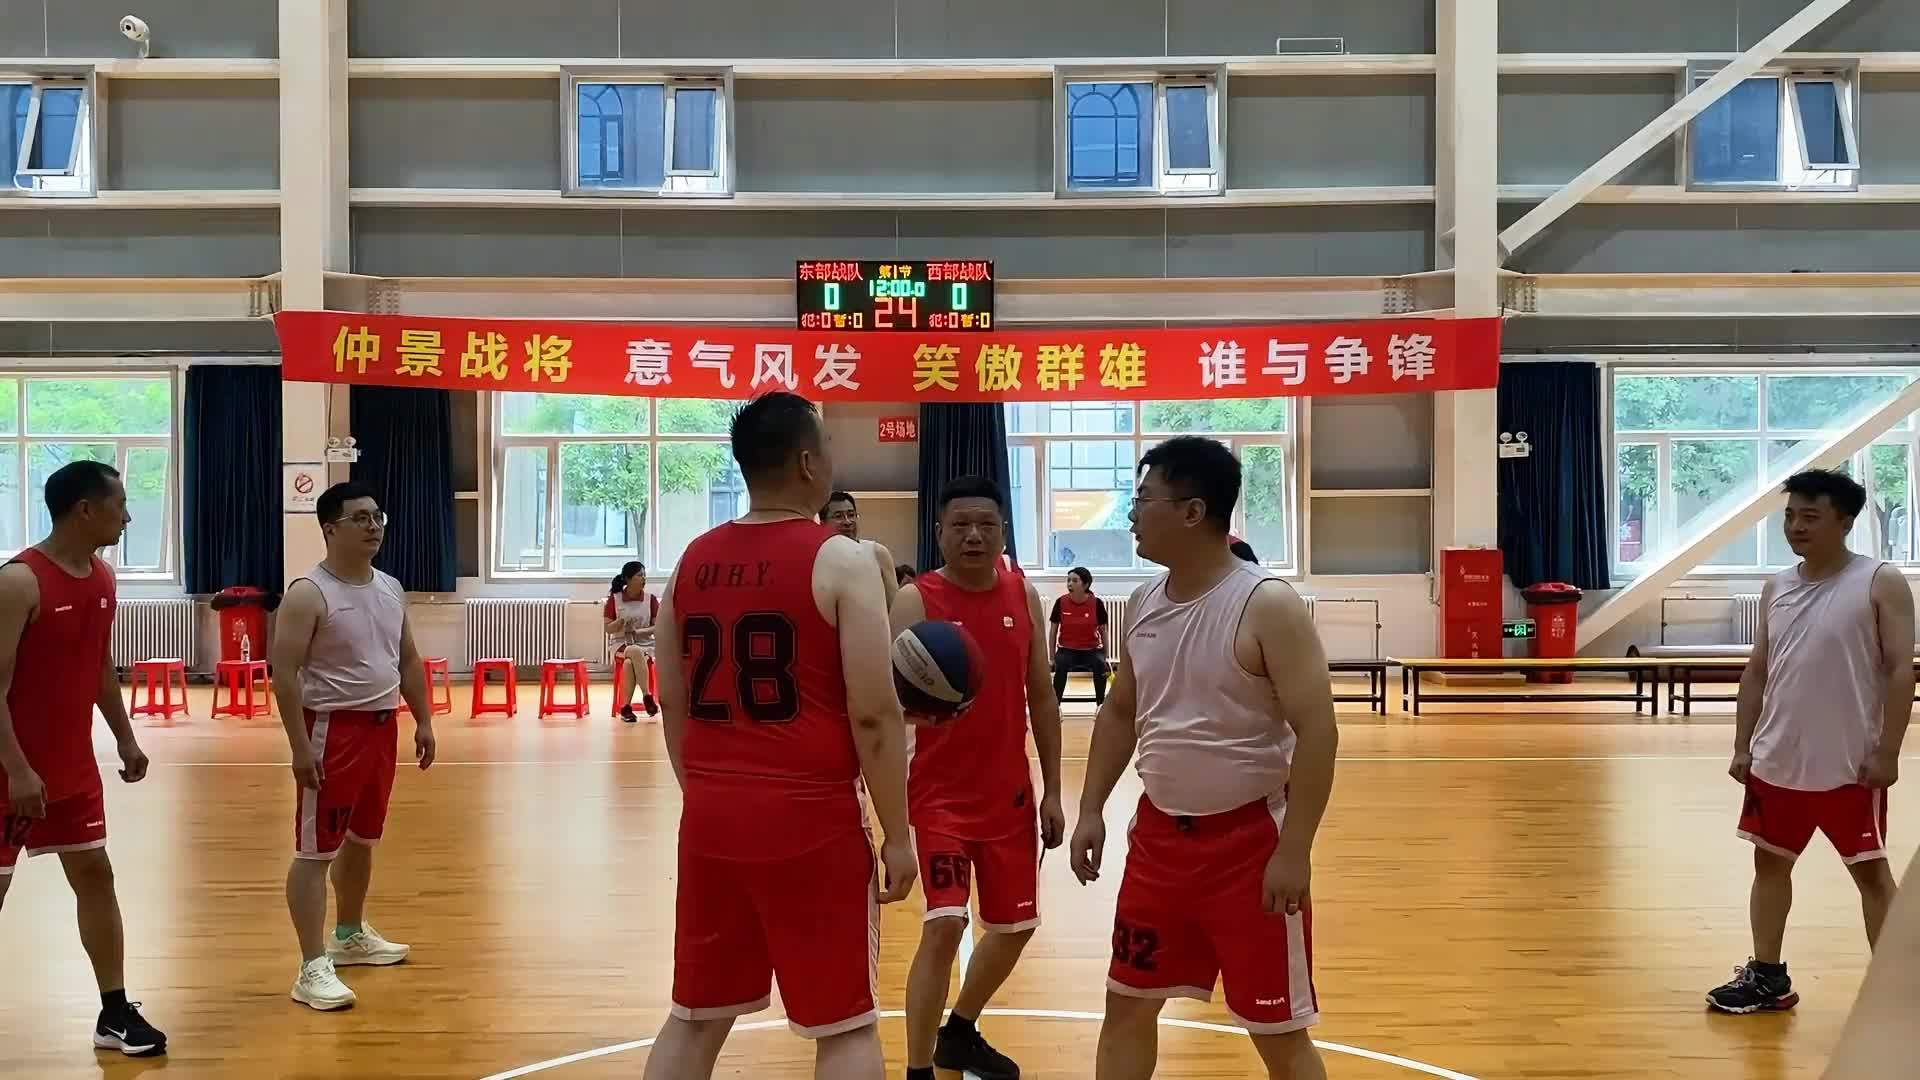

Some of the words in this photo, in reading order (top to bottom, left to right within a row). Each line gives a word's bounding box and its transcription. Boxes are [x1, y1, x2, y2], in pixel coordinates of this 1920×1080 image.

[800, 262, 864, 281] 东部战队
[879, 264, 912, 279] 第1节
[926, 262, 992, 281] 西部战队
[824, 282, 840, 310] 0
[869, 279, 926, 297] 12:00.0
[952, 282, 968, 310] 0
[874, 297, 917, 328] 24
[332, 325, 575, 384] 仲景战将
[624, 338, 863, 391] 意气风发
[912, 342, 1148, 393] 笑傲群雄
[1199, 333, 1438, 389] 谁与争锋
[879, 420, 916, 438] 2号场地
[695, 562, 720, 591] QI
[682, 611, 800, 724] 28
